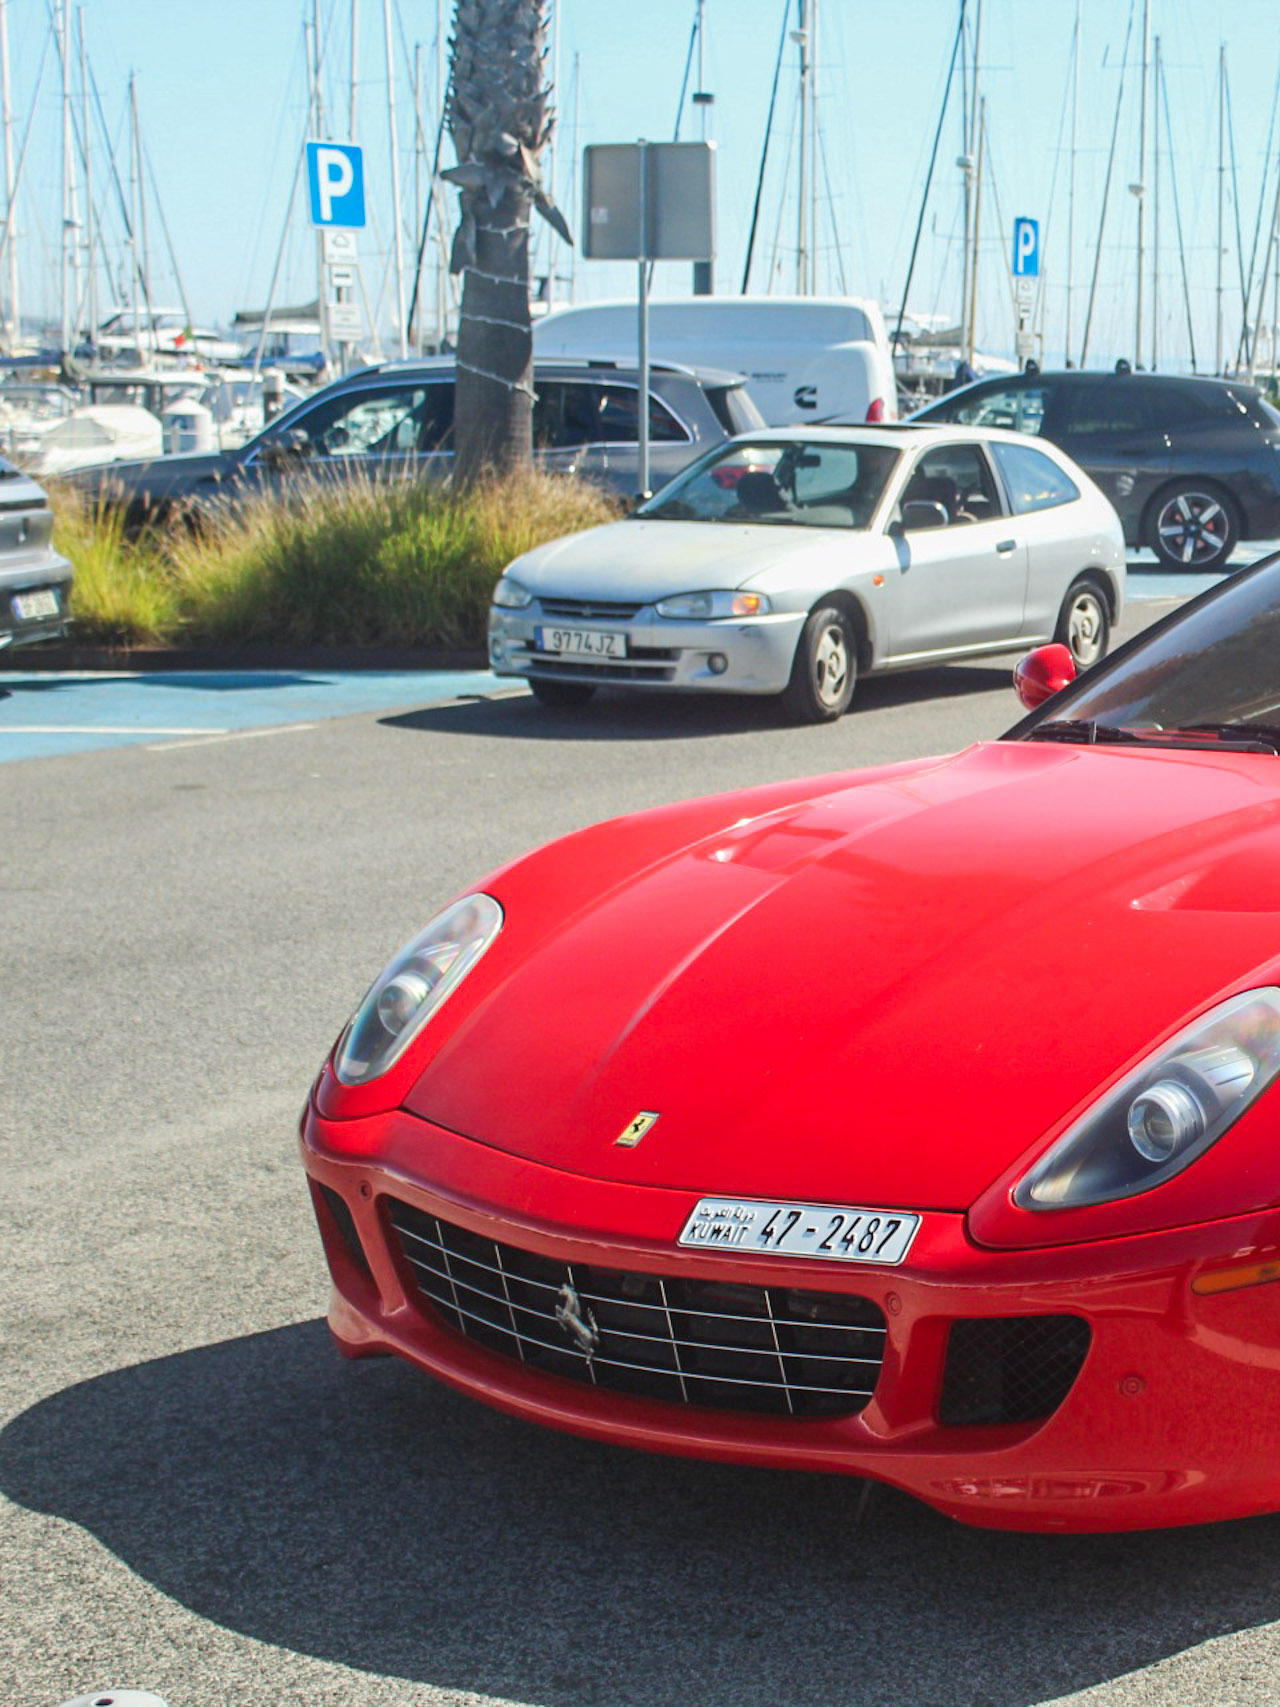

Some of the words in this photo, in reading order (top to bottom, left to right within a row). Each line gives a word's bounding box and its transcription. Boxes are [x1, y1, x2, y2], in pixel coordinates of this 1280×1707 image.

[317, 147, 354, 221] P
[1018, 222, 1035, 273] P
[688, 1222, 750, 1242] KUWAIT
